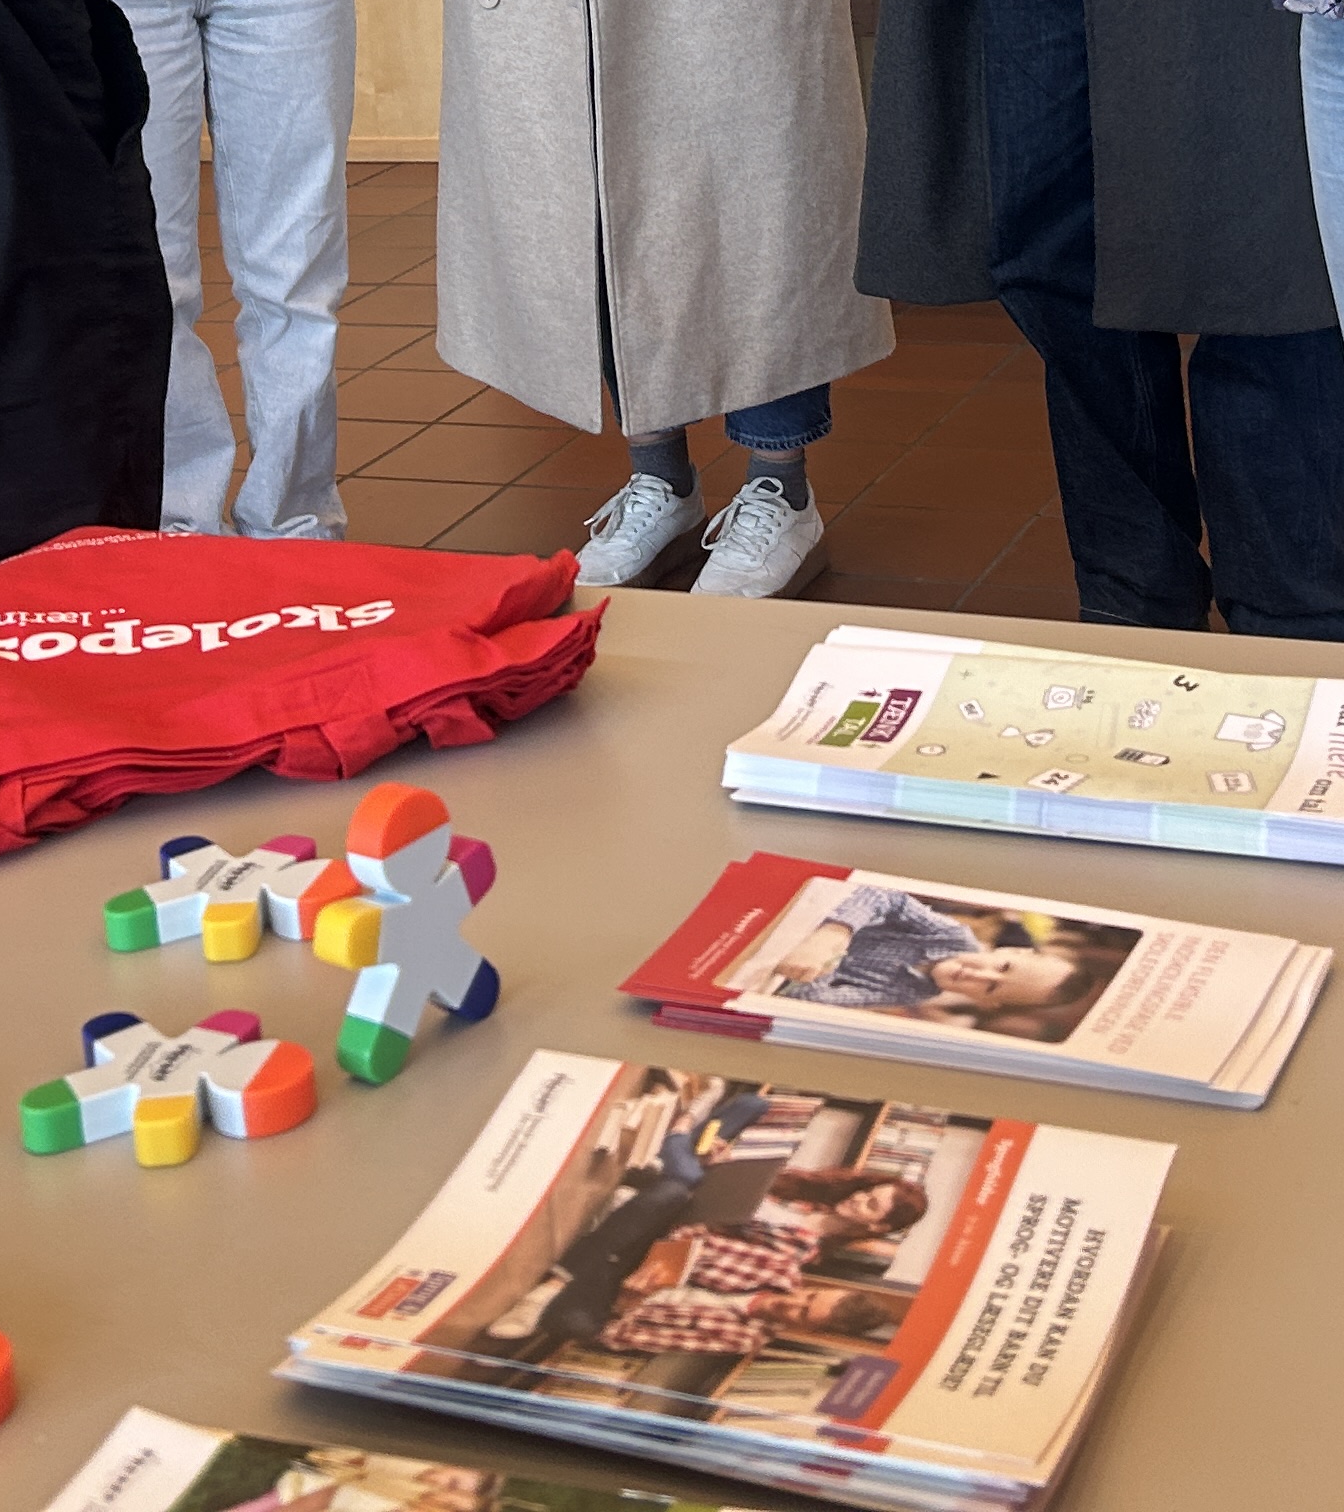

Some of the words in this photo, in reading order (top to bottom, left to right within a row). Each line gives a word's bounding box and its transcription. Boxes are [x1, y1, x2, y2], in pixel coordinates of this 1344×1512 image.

[1029, 1196, 1082, 1292] MOTIVERE
[994, 1262, 1021, 1290] OG
[1054, 1228, 1107, 1321] HVORDAN
[1014, 1295, 1044, 1328] DIT
[990, 1329, 1028, 1374] BARN
[1034, 1322, 1069, 1361] KAN
